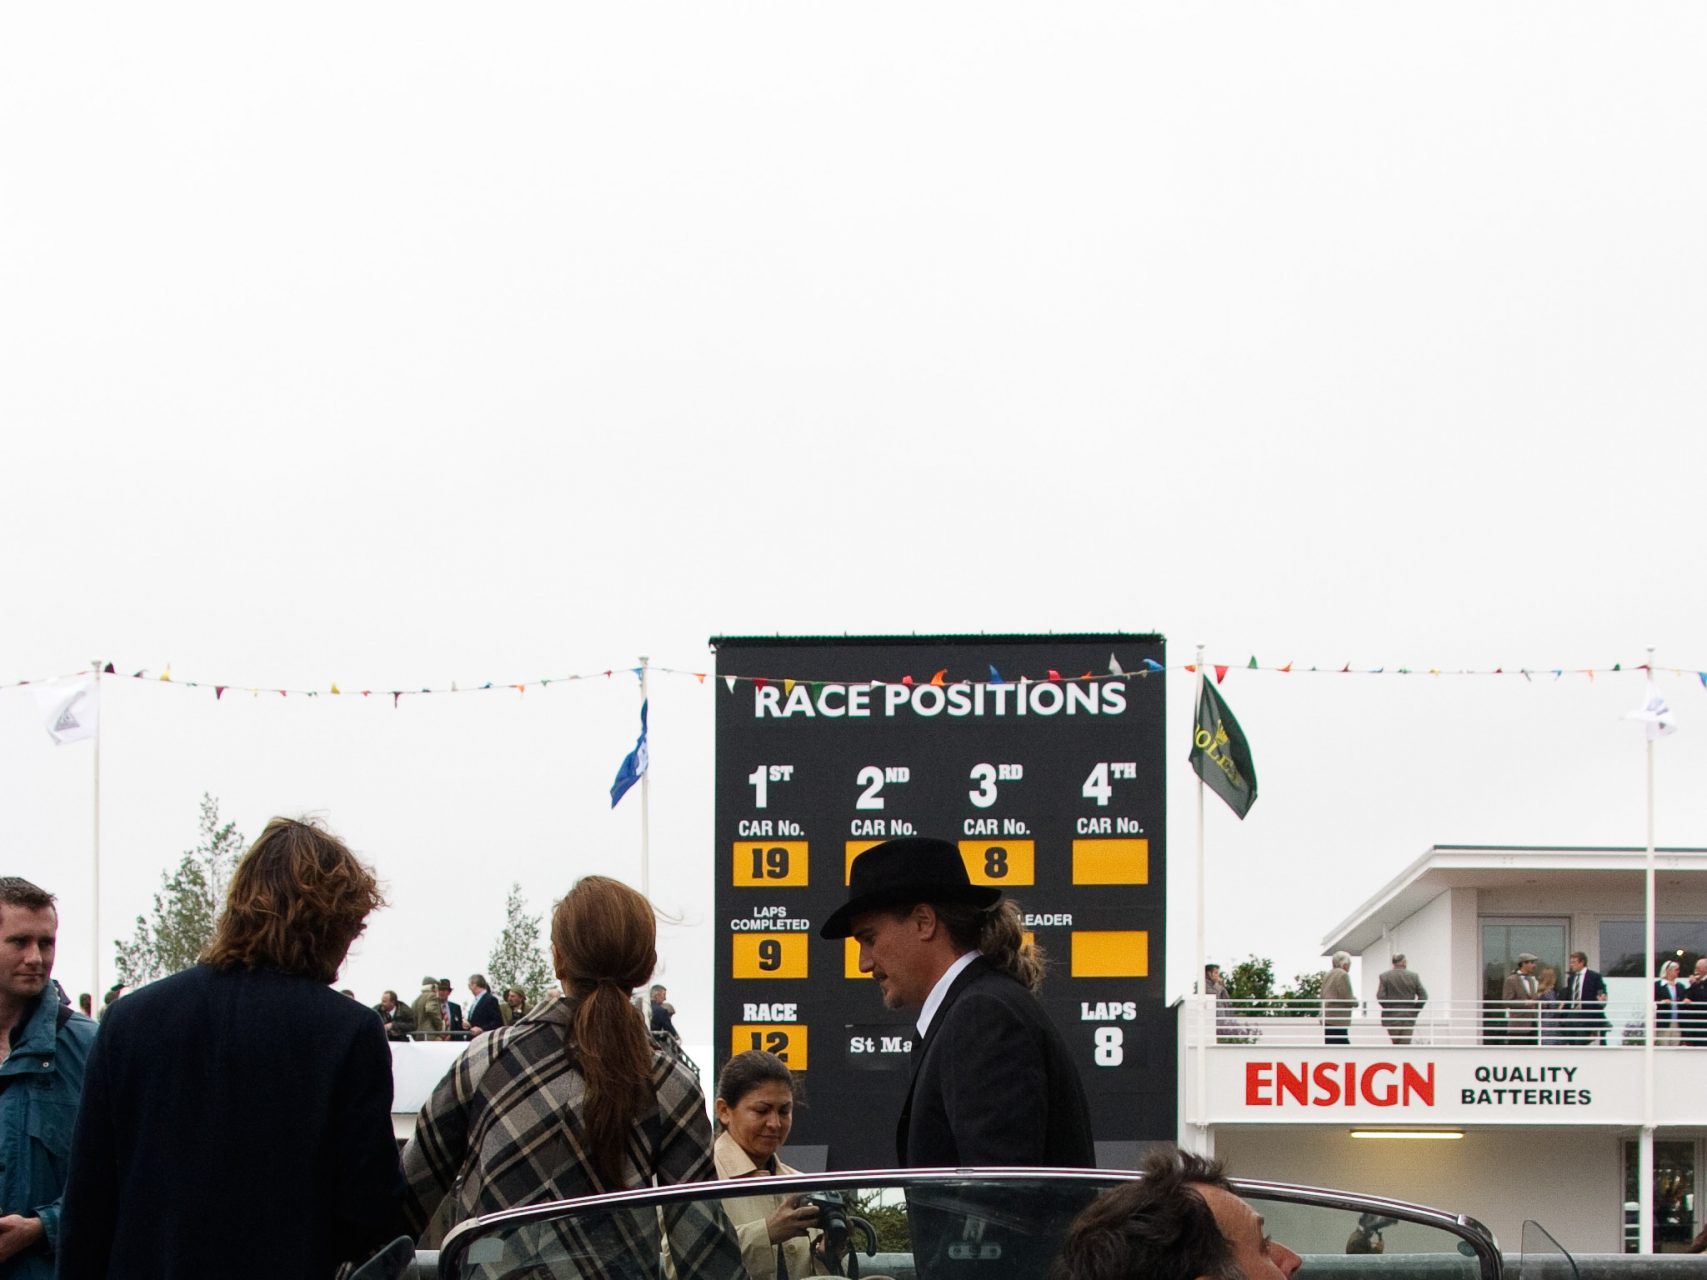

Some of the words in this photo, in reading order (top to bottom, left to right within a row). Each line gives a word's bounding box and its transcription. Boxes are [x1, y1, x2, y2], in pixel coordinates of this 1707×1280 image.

[754, 684, 871, 718] RACE
[885, 682, 1127, 717] POSITIONS
[1195, 723, 1242, 787] OLE
[748, 765, 794, 808] 1ST
[855, 765, 910, 809] 2ND
[969, 763, 1023, 808] 3RD
[1082, 762, 1137, 806] 4TH
[738, 820, 773, 836] CAR
[777, 820, 805, 836] No.
[850, 819, 885, 836] CAR
[890, 819, 918, 836] No.
[963, 818, 999, 835] CAR
[1003, 818, 1031, 835] No.
[1076, 817, 1112, 834] CAR
[1116, 817, 1144, 834] No.
[752, 847, 789, 879] 19
[984, 846, 1008, 879] 8
[730, 918, 810, 931] COMPLETED
[753, 906, 787, 918] LAPS
[758, 939, 782, 971] 9
[743, 1003, 797, 1022] RACE
[1080, 1001, 1137, 1021] LAPS
[850, 1036, 875, 1053] St
[1094, 1026, 1124, 1067] 8
[1245, 1061, 1435, 1107] ENSIGN
[1474, 1066, 1578, 1084] QUALITY
[1461, 1088, 1592, 1106] BATTERIES
